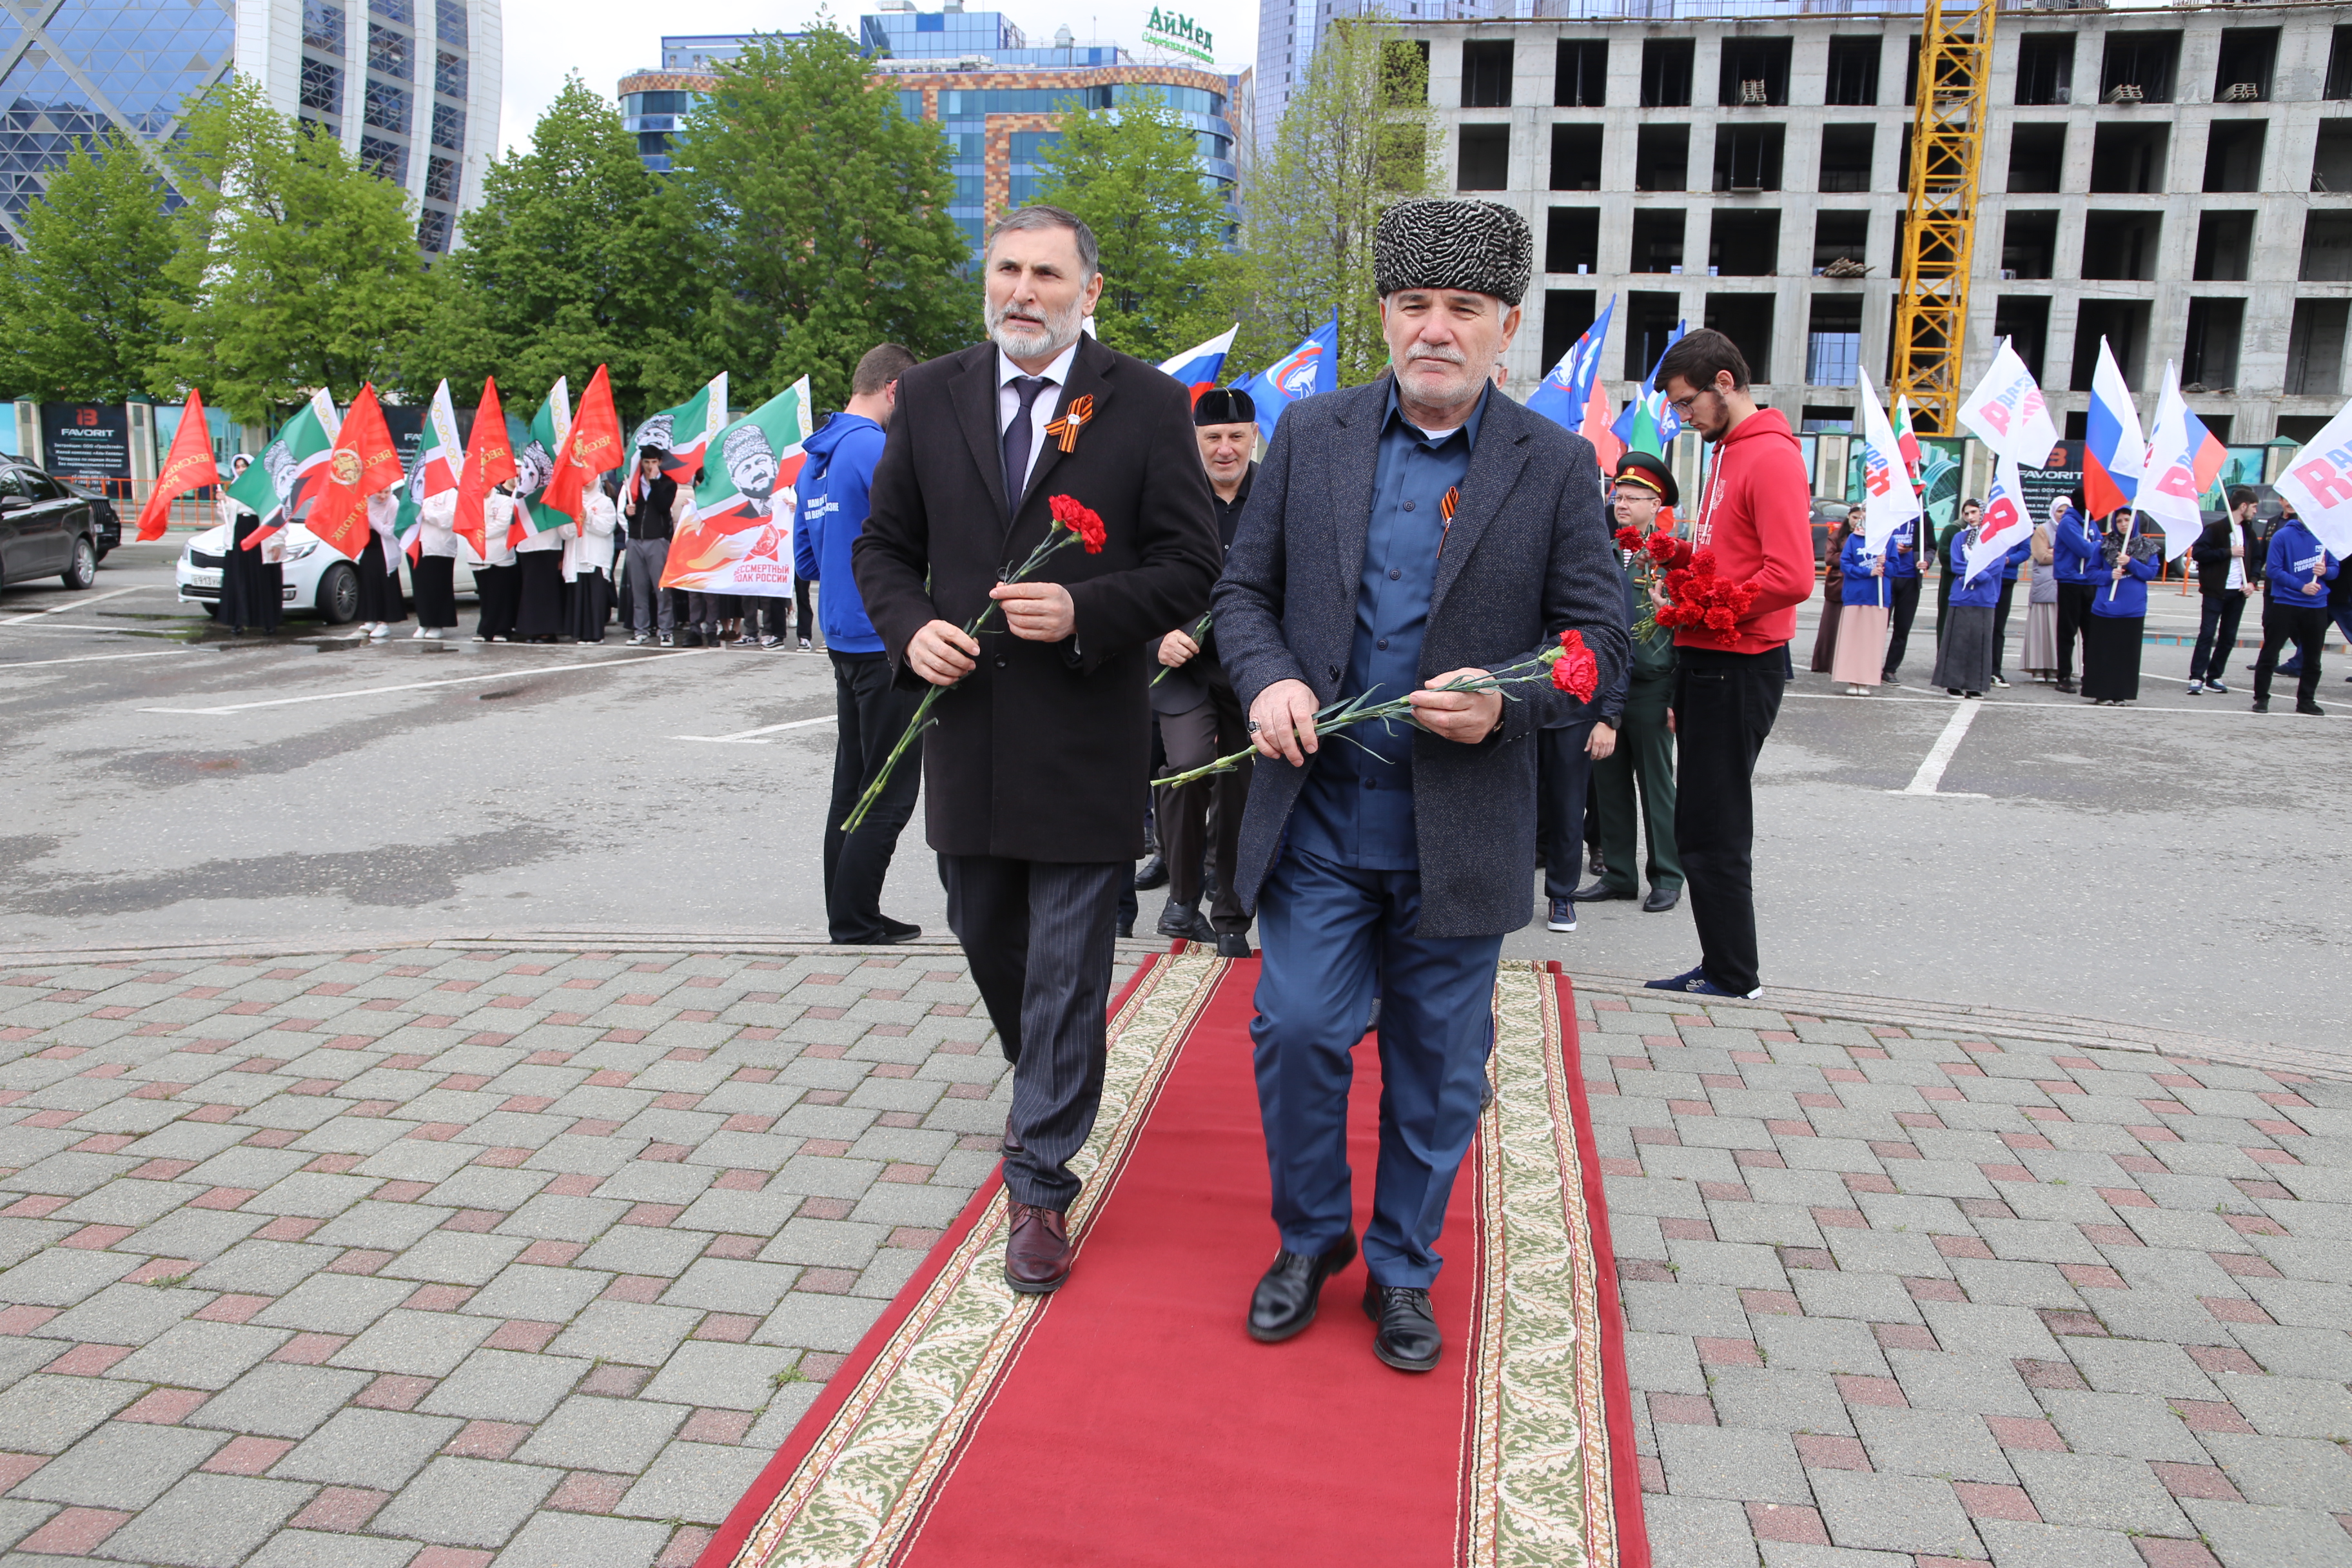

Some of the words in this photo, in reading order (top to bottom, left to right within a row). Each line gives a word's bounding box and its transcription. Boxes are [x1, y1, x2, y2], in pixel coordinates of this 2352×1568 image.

[1146, 6, 1213, 53] АйМед
[61, 428, 114, 436] FAVORIT
[2019, 470, 2084, 480] FAVORIT
[807, 497, 819, 509] НАМ
[756, 573, 788, 583] РОССИИ
